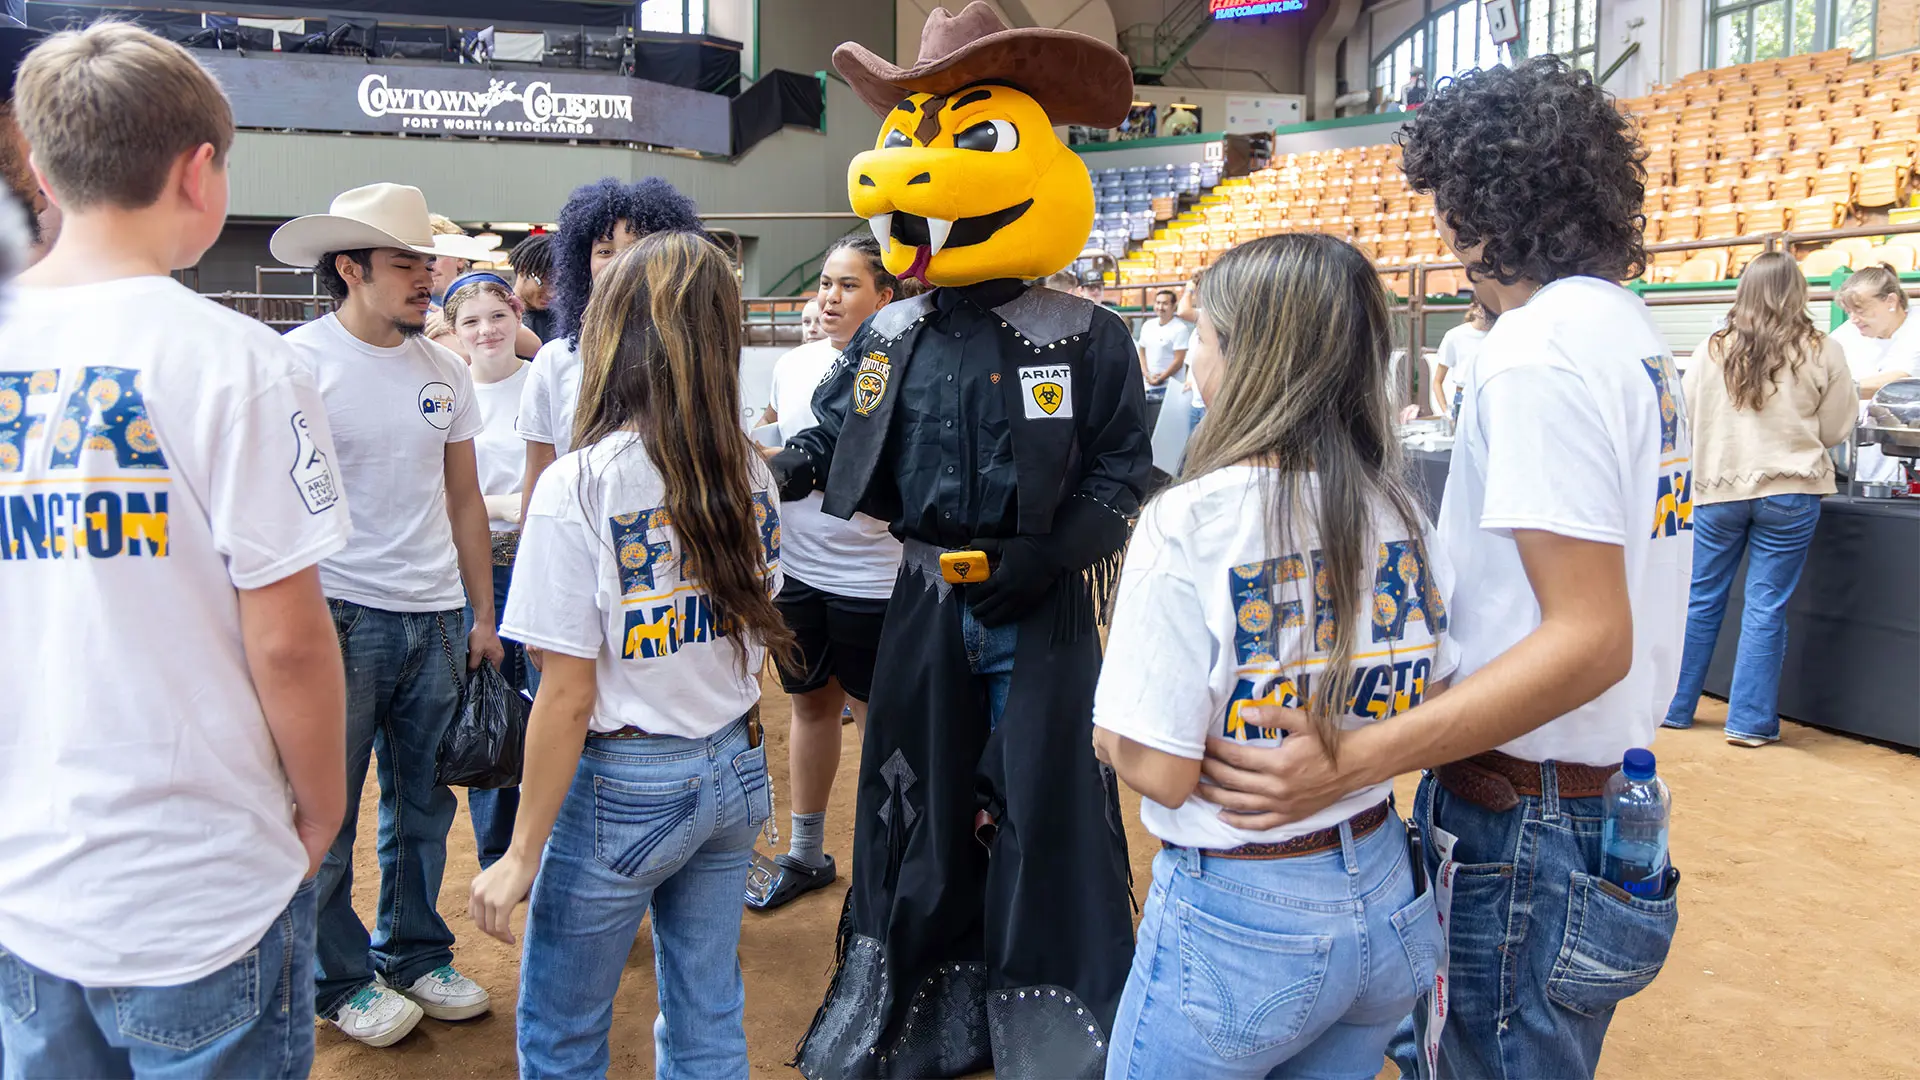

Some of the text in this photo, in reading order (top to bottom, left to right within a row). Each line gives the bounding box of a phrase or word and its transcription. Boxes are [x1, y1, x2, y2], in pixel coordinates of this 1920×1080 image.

[1495, 6, 1506, 30] J
[357, 73, 633, 124] COWTOWN COLISEUM
[402, 117, 594, 134] FORT WORTH STOCKYARDS
[869, 352, 889, 364] TEXAS
[1021, 369, 1069, 380] ARIAT
[434, 401, 453, 413] FFA
